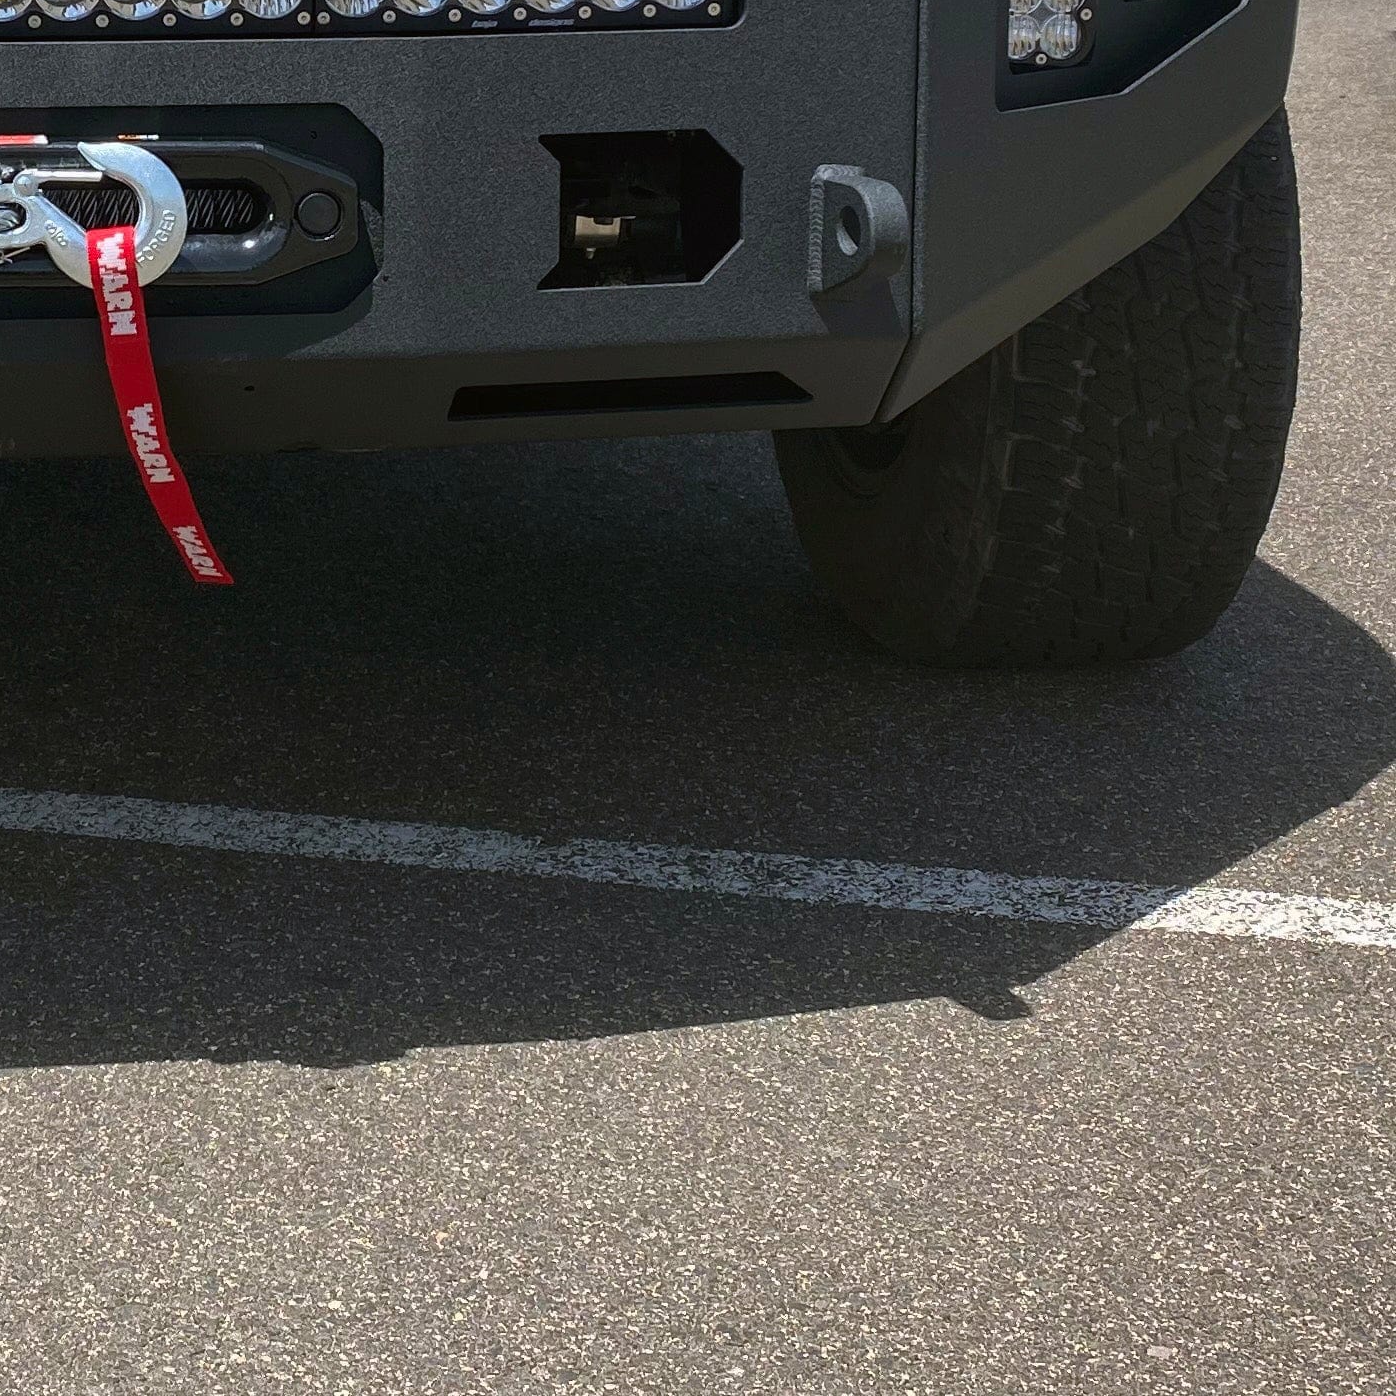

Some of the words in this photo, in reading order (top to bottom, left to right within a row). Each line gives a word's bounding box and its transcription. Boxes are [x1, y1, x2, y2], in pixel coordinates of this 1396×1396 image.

[136, 209, 177, 266] FORGED
[96, 232, 137, 336] WARN
[126, 403, 175, 483] WARN
[172, 525, 223, 577] WARN
